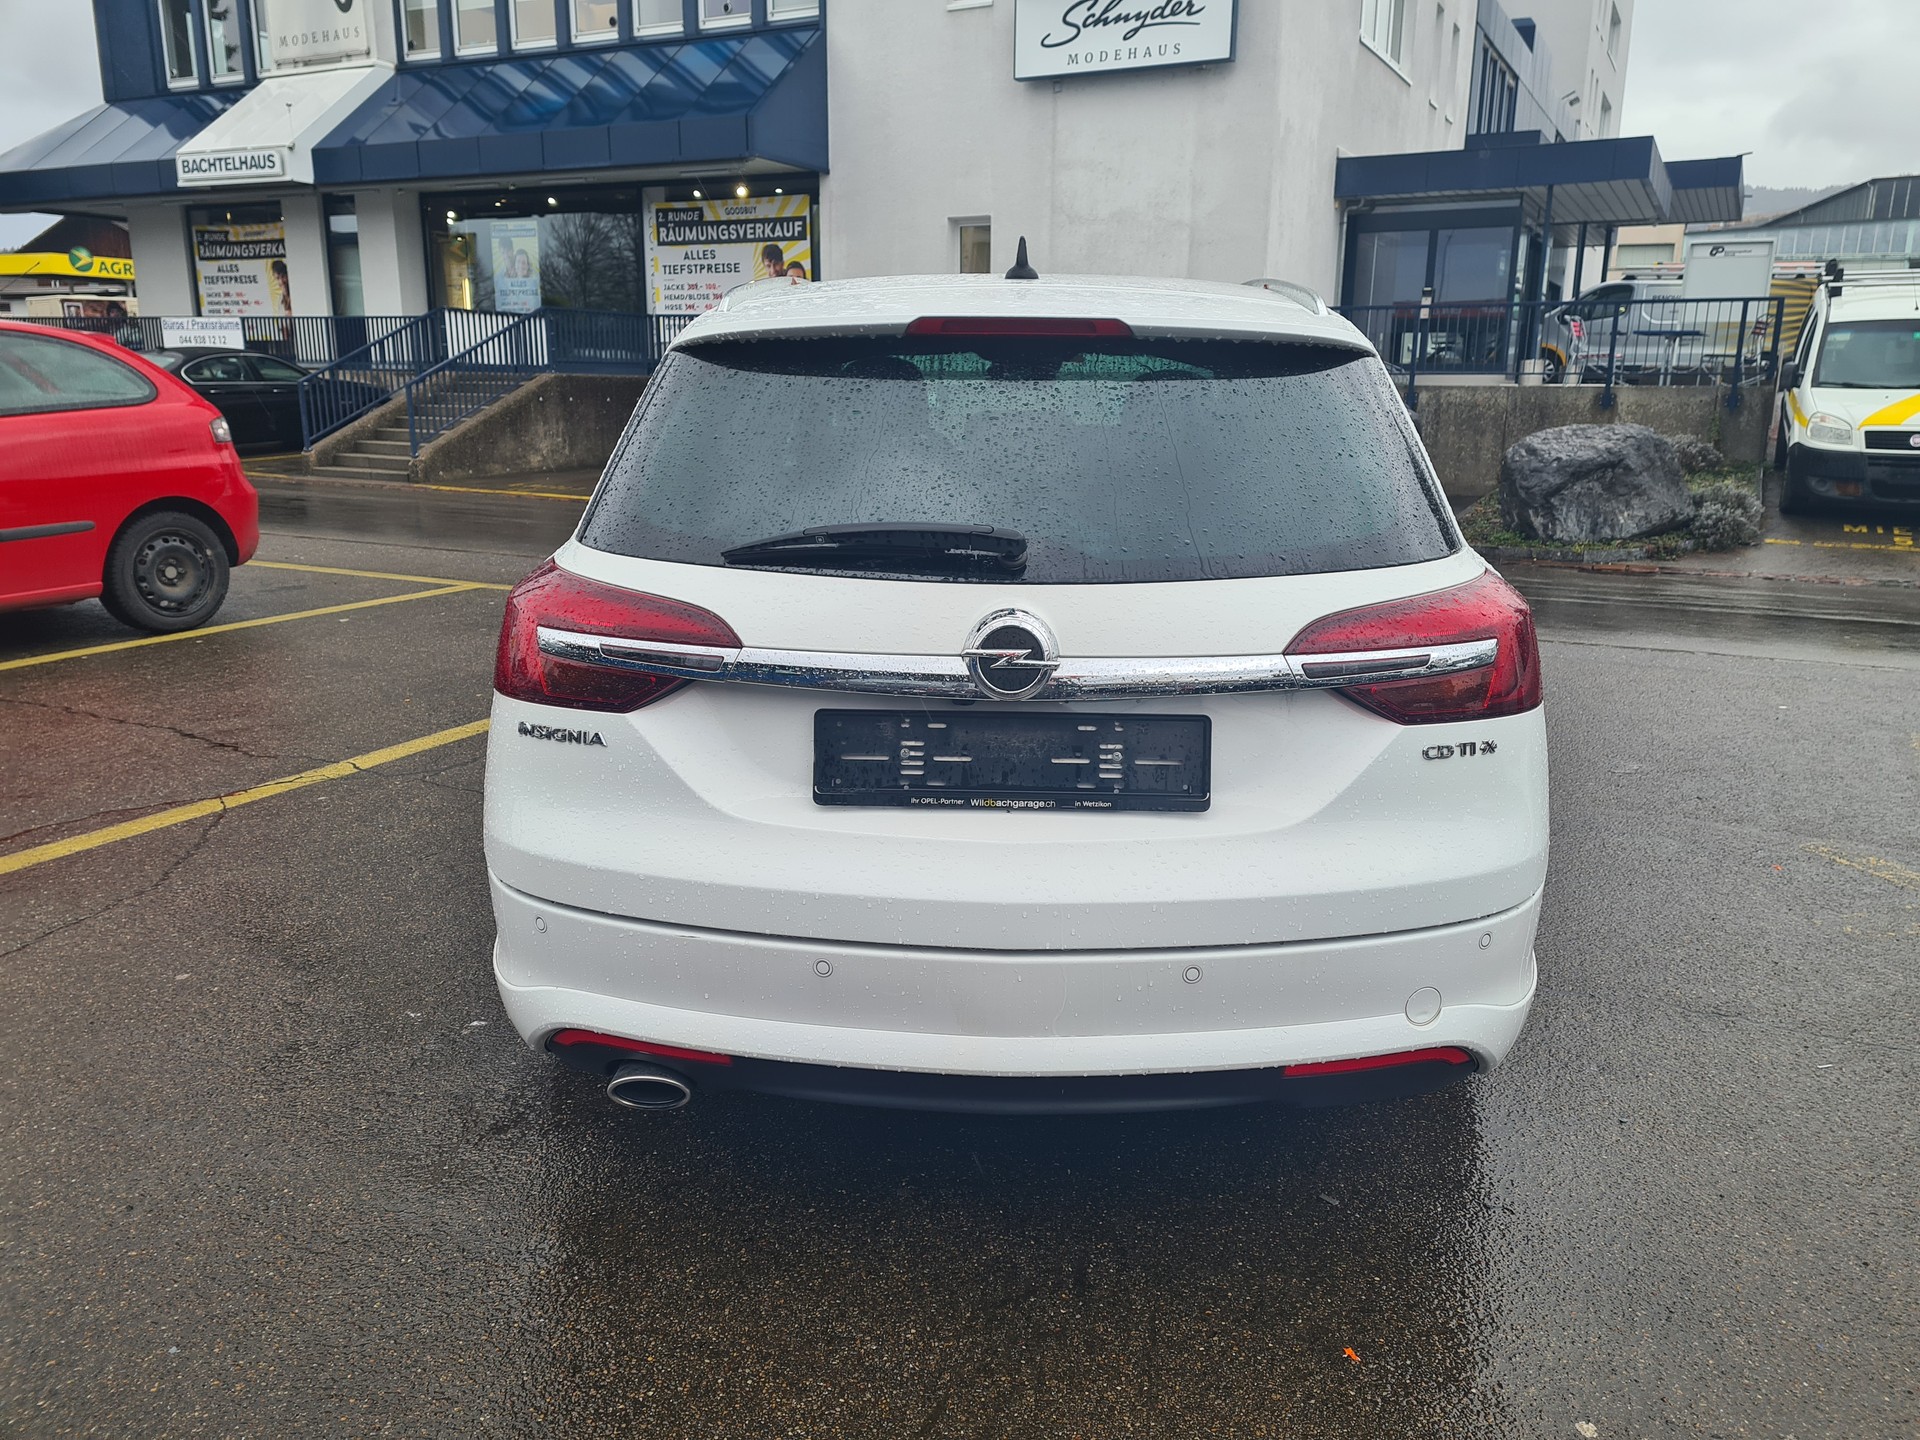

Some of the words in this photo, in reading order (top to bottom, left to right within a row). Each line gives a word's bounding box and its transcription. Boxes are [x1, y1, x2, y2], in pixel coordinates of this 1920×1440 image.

[279, 25, 361, 48] MODEHAUS
[1066, 43, 1182, 66] MODEHAUS
[181, 154, 276, 174] BACHTELHAUS
[658, 212, 666, 222] 2.
[668, 210, 700, 222] RUNDE
[659, 221, 804, 243] RÄUMUNGSVERKAUF
[683, 249, 717, 261] ALLES
[217, 263, 240, 273] ALLES
[662, 262, 741, 276] TIEFSTPREISE
[203, 274, 259, 286] TIEFSTPREISE
[663, 283, 685, 291] JACKE
[178, 335, 193, 345] 044
[208, 335, 217, 345] 12
[219, 335, 228, 345] 12
[518, 721, 607, 747] INSIGNIA
[920, 797, 965, 805] OPEL-Partner
[970, 798, 1056, 809] Wildbachgarage.ch
[1082, 800, 1112, 808] Wetzikon
